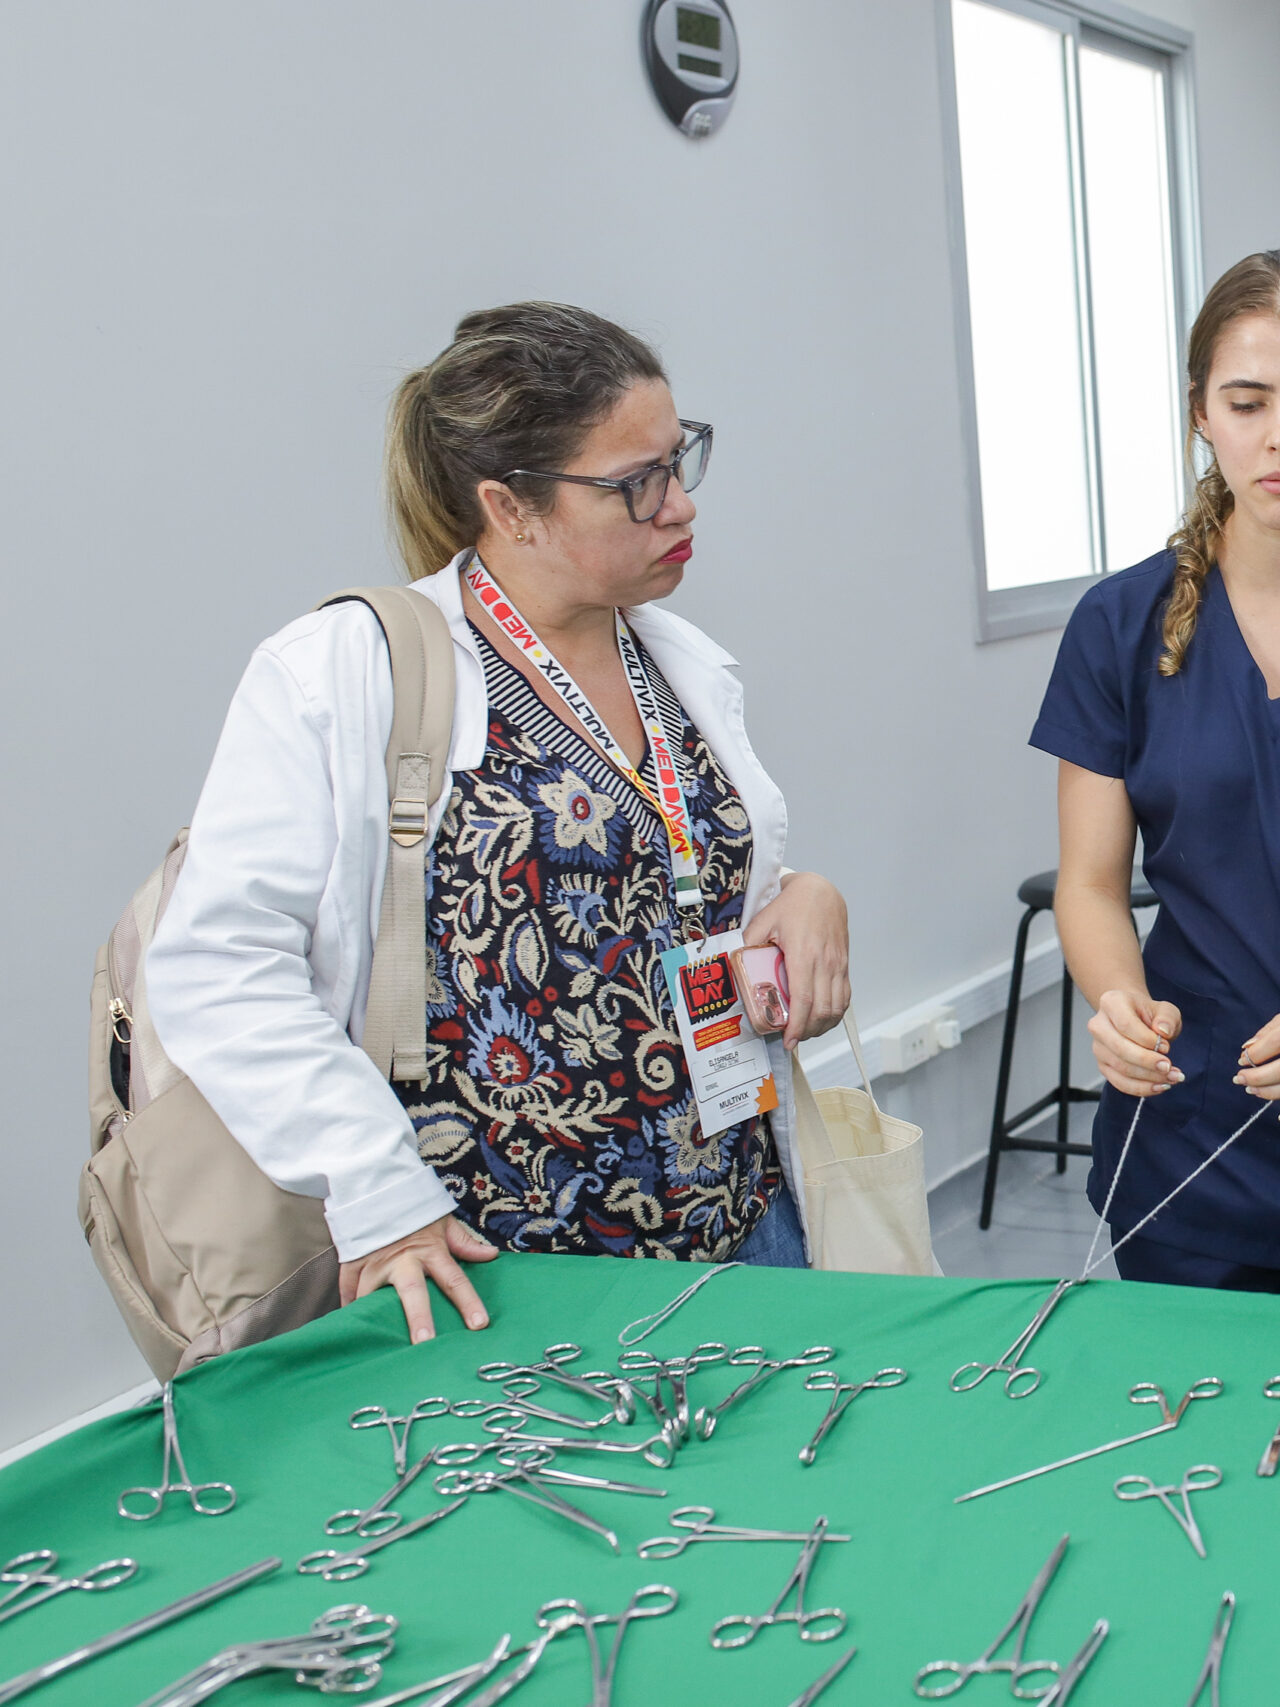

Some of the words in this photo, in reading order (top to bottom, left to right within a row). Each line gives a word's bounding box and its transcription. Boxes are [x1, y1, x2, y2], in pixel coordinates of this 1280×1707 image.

[620, 636, 659, 722] MULTIVIX
[539, 659, 615, 750] MULTIVIX
[687, 962, 724, 988] MED
[690, 979, 724, 1008] DAY
[719, 1091, 749, 1110] MULTIVIX
